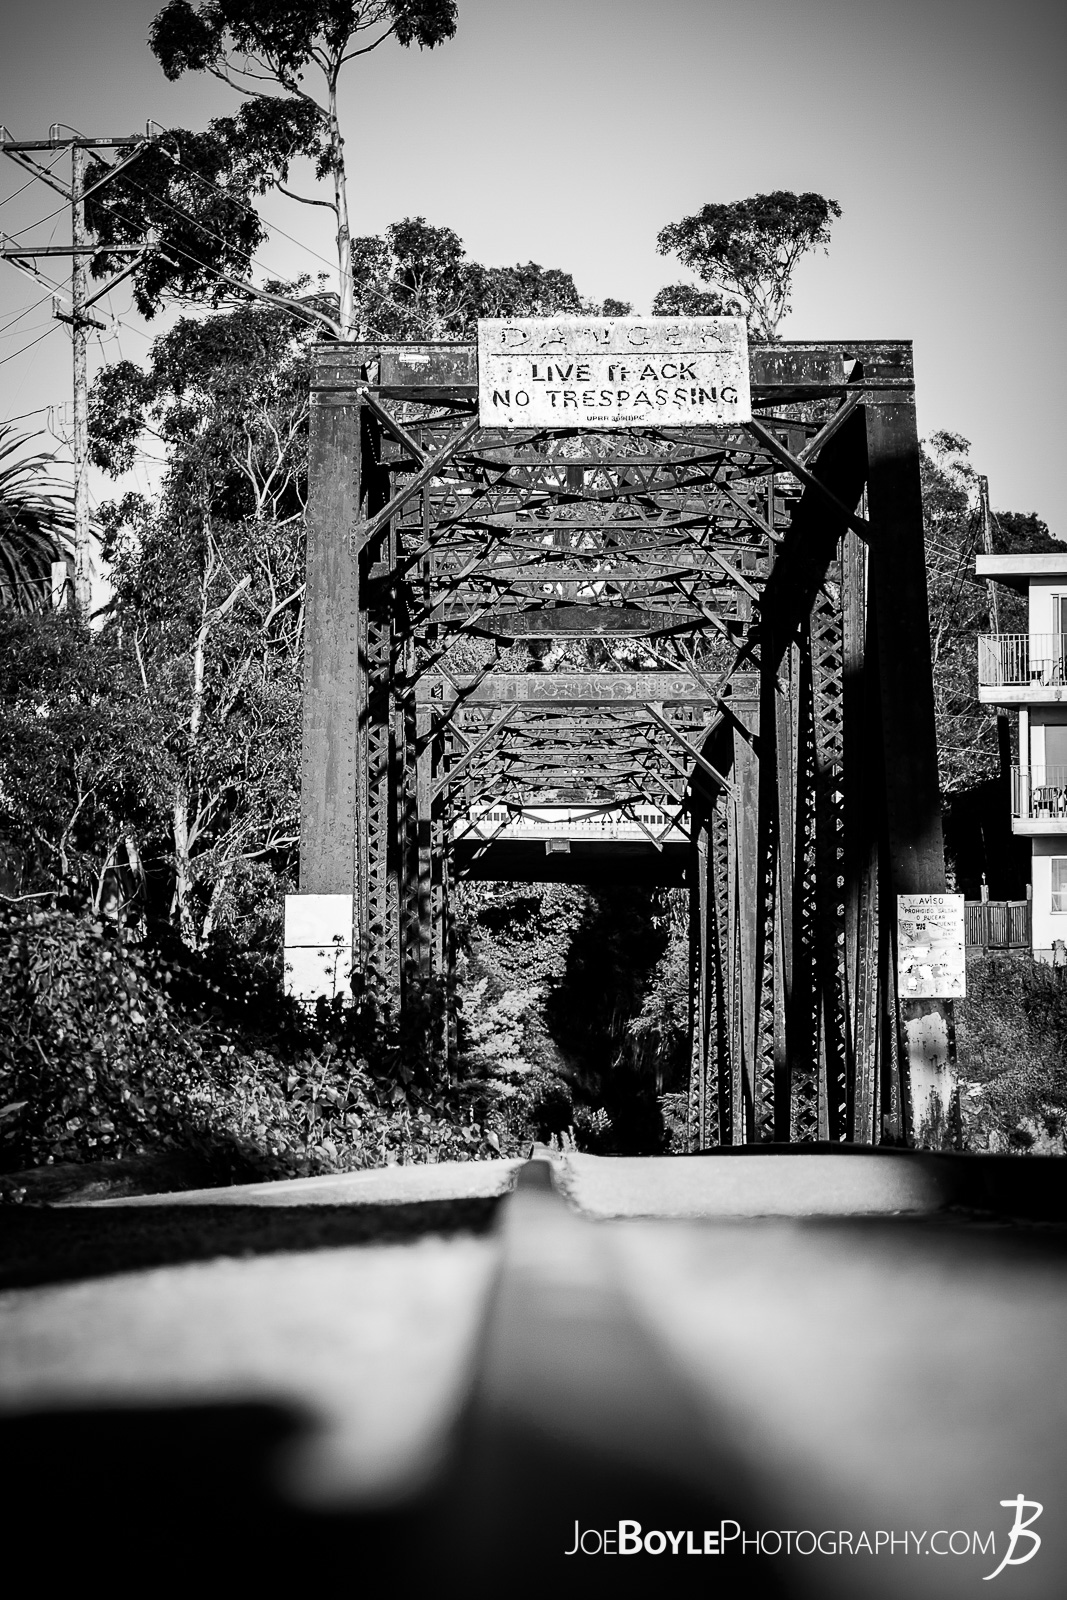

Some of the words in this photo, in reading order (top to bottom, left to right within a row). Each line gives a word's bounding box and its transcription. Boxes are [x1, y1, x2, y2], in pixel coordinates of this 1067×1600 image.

[501, 326, 723, 347] DANGER
[532, 363, 590, 382] LIVE
[492, 390, 530, 408] NO
[546, 386, 739, 408] TRESPASSING
